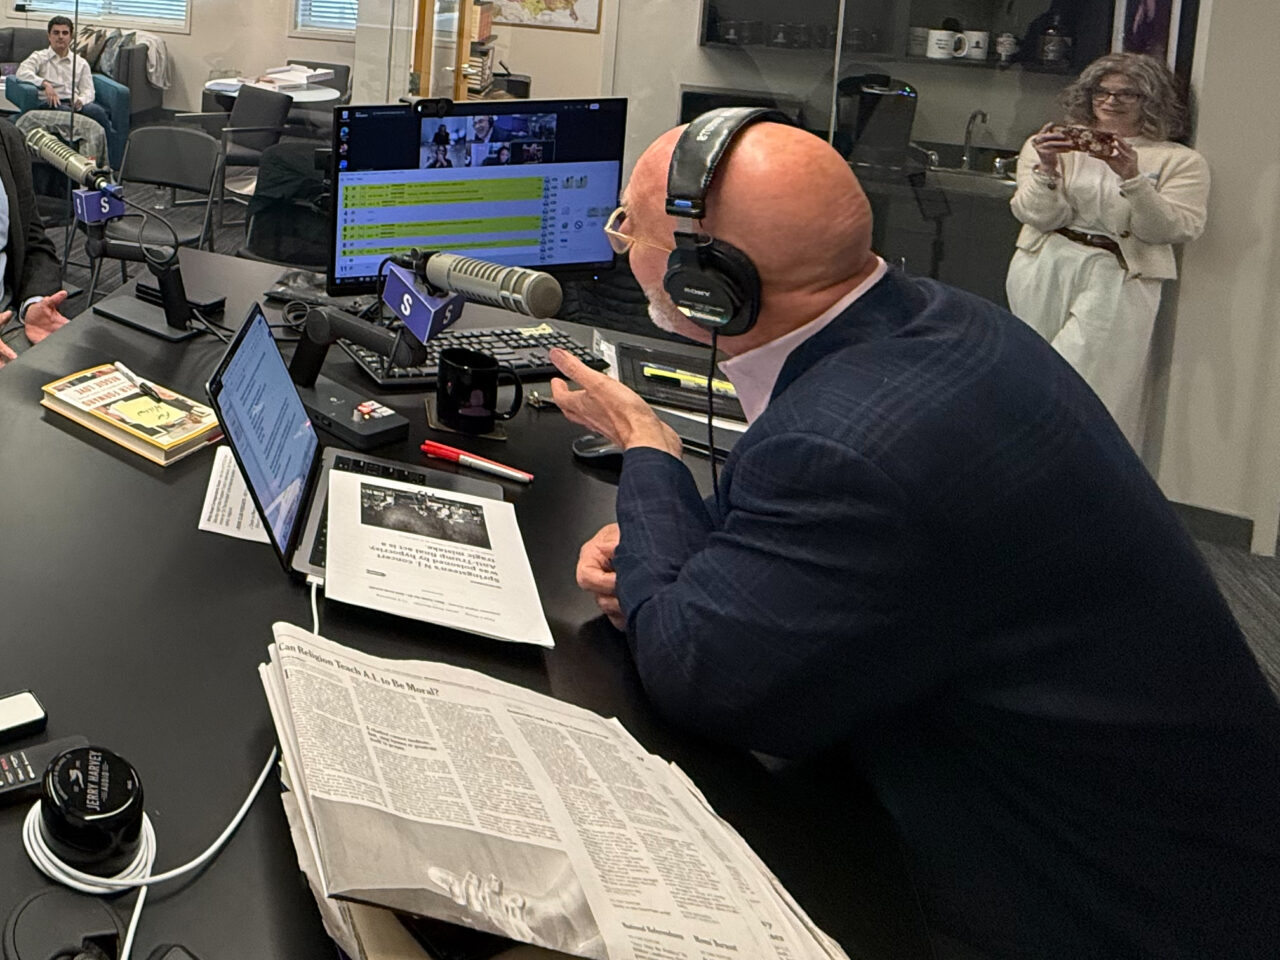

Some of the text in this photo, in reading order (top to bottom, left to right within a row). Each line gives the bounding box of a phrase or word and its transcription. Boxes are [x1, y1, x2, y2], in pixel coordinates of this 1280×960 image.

[100, 196, 110, 213] S
[400, 293, 413, 316] S
[442, 304, 454, 324] S
[399, 545, 414, 553] act
[377, 553, 413, 565] concert
[418, 554, 432, 563] by
[432, 558, 477, 571] poisoned
[467, 552, 496, 563] tragic
[434, 565, 500, 583] Springsteen's
[478, 567, 499, 576] was
[278, 642, 297, 653] Can
[297, 645, 334, 667] Religion
[334, 659, 362, 676] Teach
[381, 677, 391, 686] to
[392, 678, 406, 690] Be
[406, 683, 440, 697] Moral?
[86, 750, 102, 811] JERRY HARVEY
